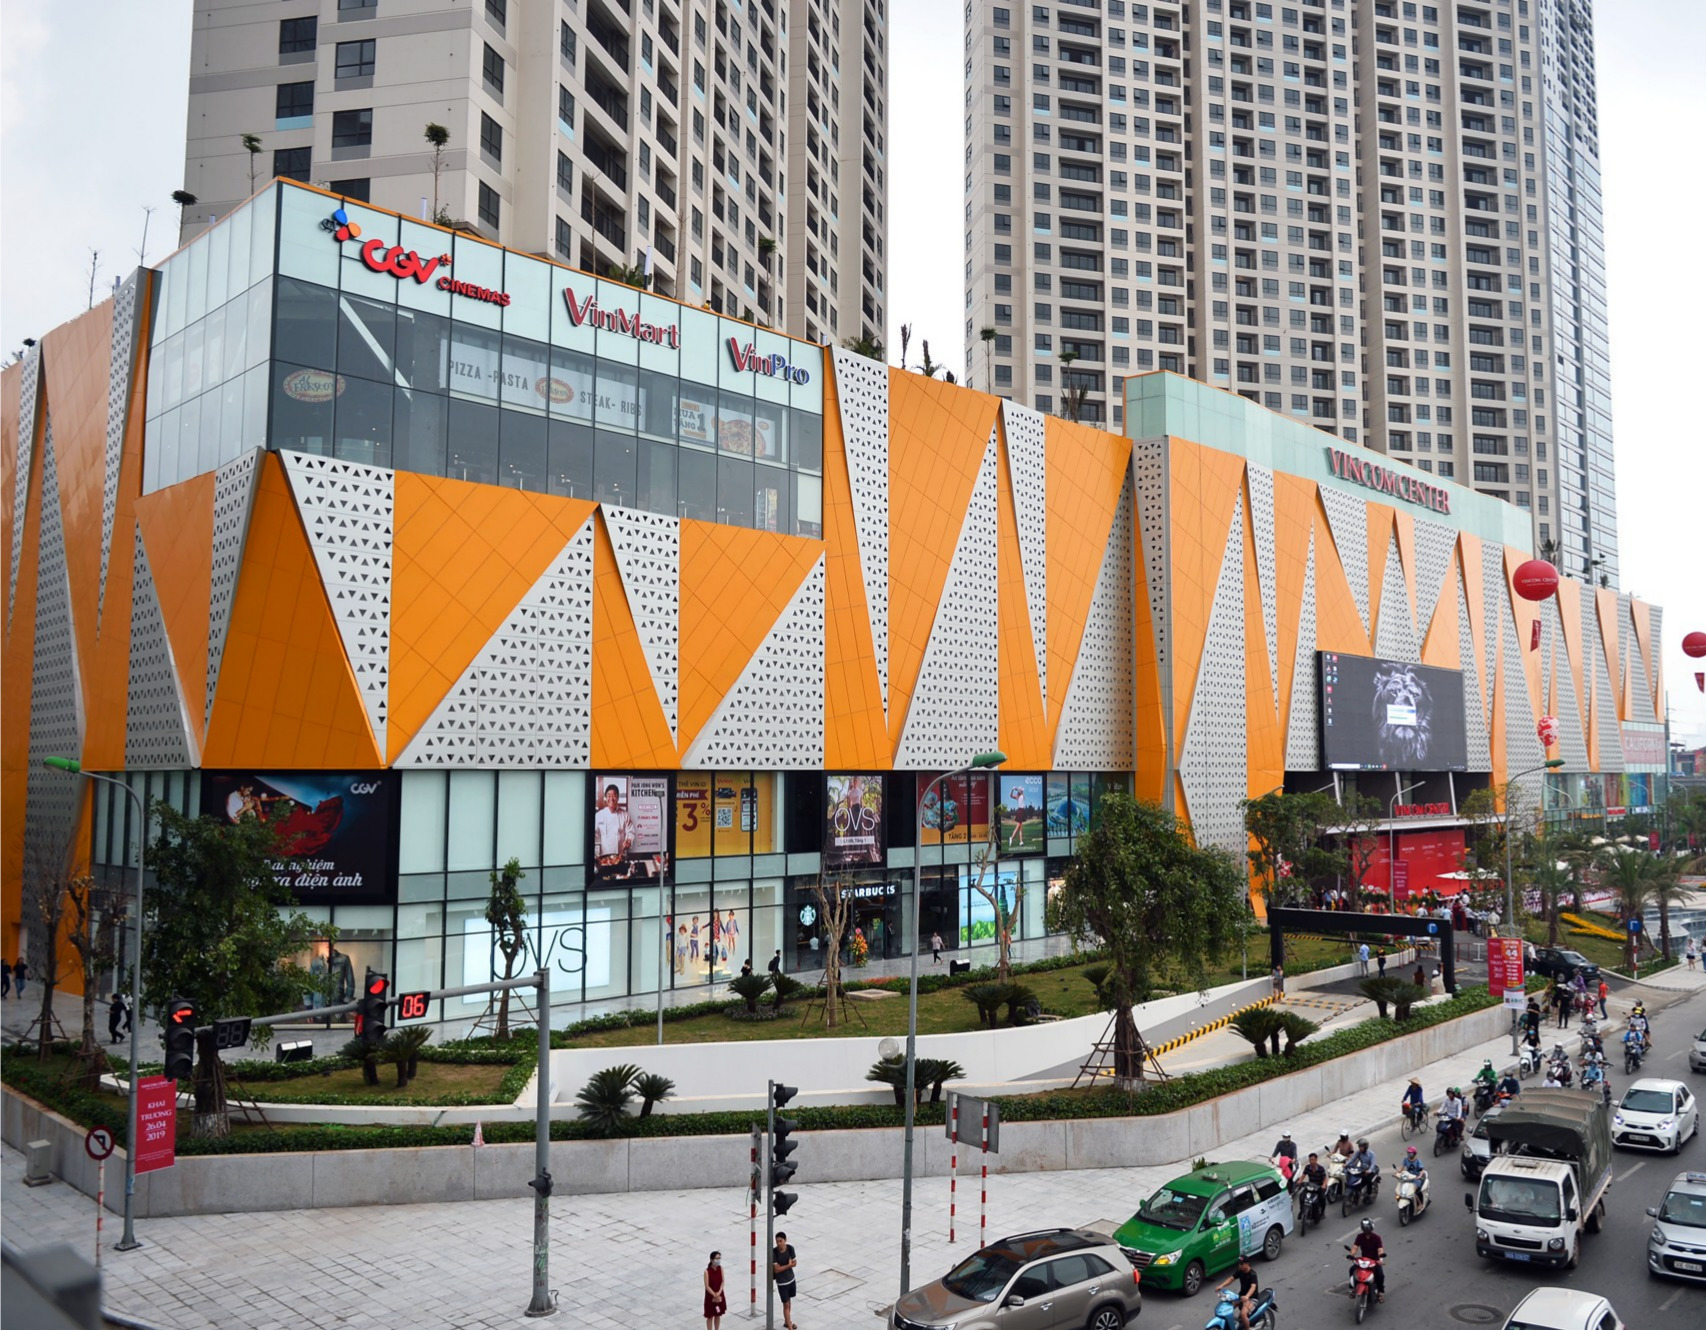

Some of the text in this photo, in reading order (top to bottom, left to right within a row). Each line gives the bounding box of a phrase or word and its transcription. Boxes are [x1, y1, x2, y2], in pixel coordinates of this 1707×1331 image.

[362, 239, 440, 284] CGV
[437, 276, 511, 307] CINEMAS
[565, 287, 681, 349] VinMart
[450, 360, 481, 380] PIZZA
[728, 336, 810, 385] VinPro
[621, 400, 642, 417] RIBS
[1327, 447, 1451, 515] VINCOM CENTER
[350, 783, 377, 794] CGV
[834, 807, 875, 832] OVS
[1425, 802, 1450, 815] CENTER
[294, 873, 329, 890] điện
[332, 872, 363, 887] ảnh
[491, 927, 586, 980] OVS
[402, 994, 425, 1018] 06
[146, 1131, 166, 1141] 2019
